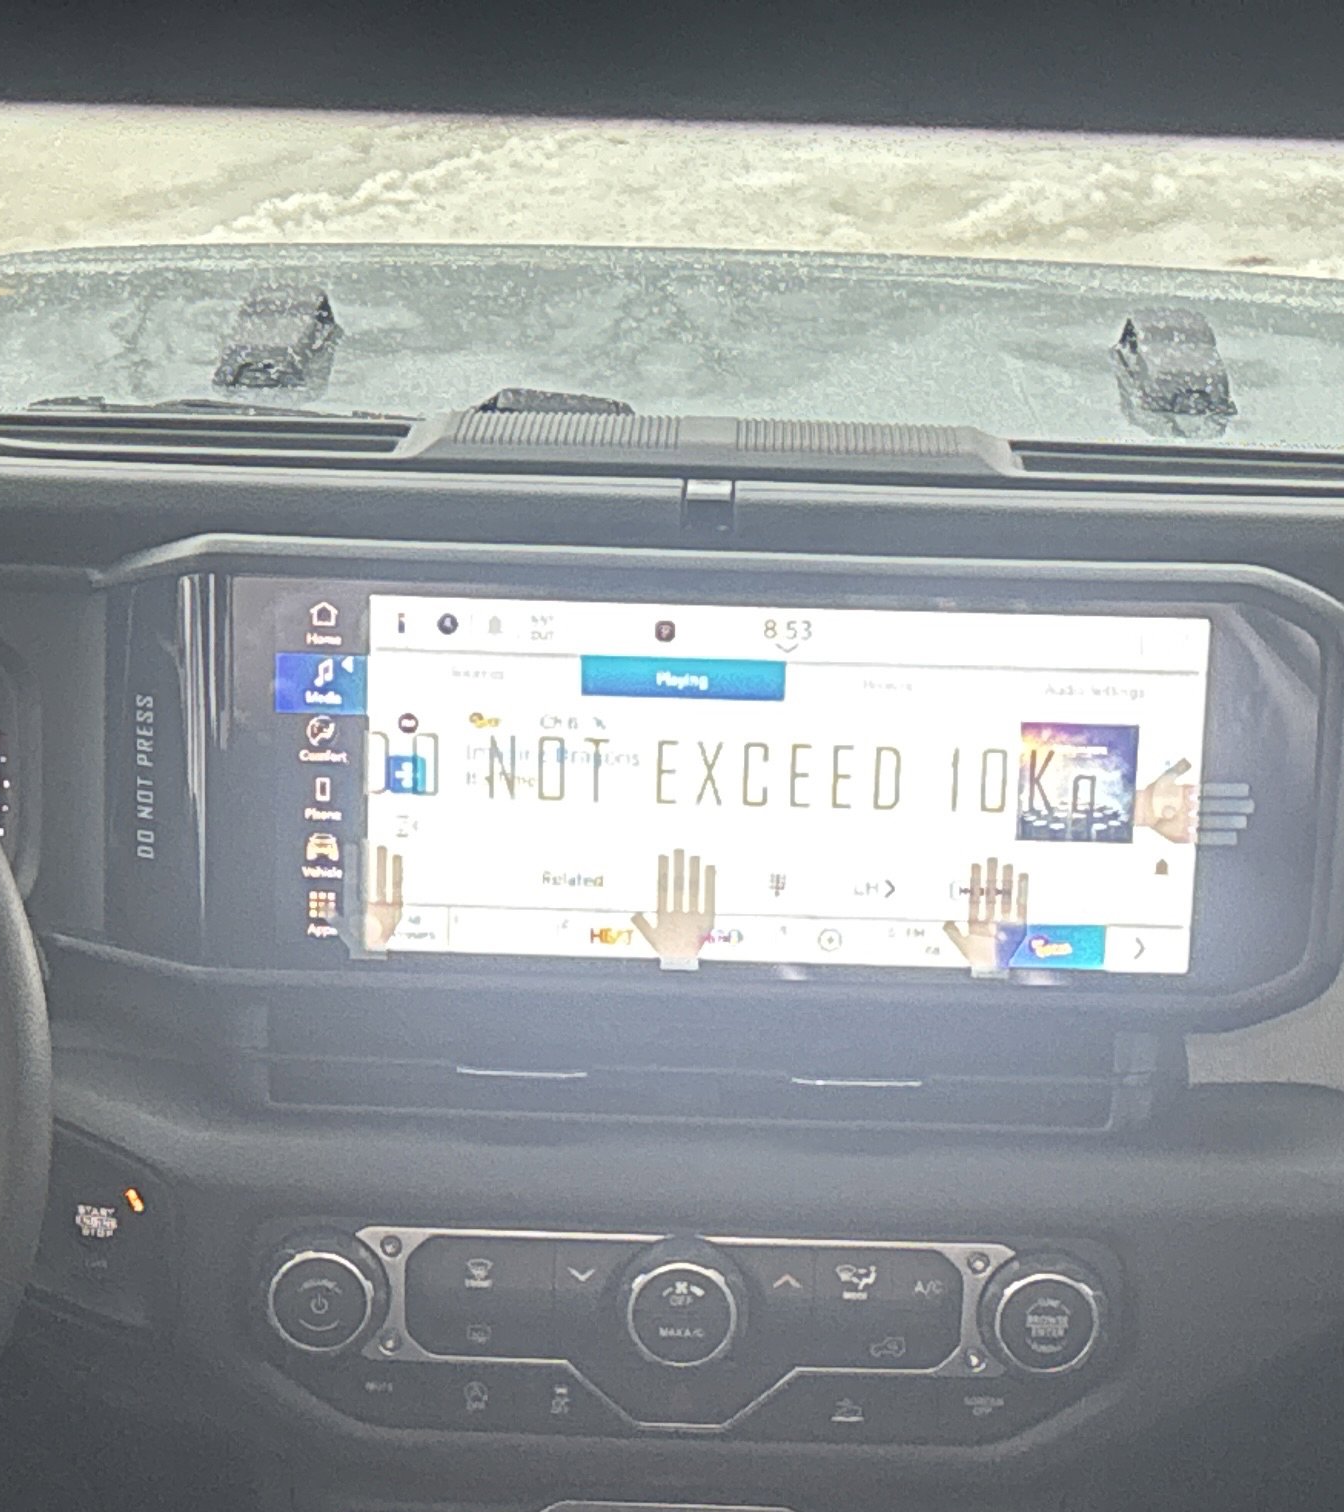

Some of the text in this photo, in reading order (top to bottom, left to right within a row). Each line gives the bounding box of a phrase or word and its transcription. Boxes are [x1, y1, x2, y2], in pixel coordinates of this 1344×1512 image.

[763, 619, 813, 640] 853
[136, 694, 155, 860] DO NOT PRESS
[489, 734, 610, 804] NOT
[657, 739, 901, 810] EXCEED
[914, 1280, 943, 1295] A/C
